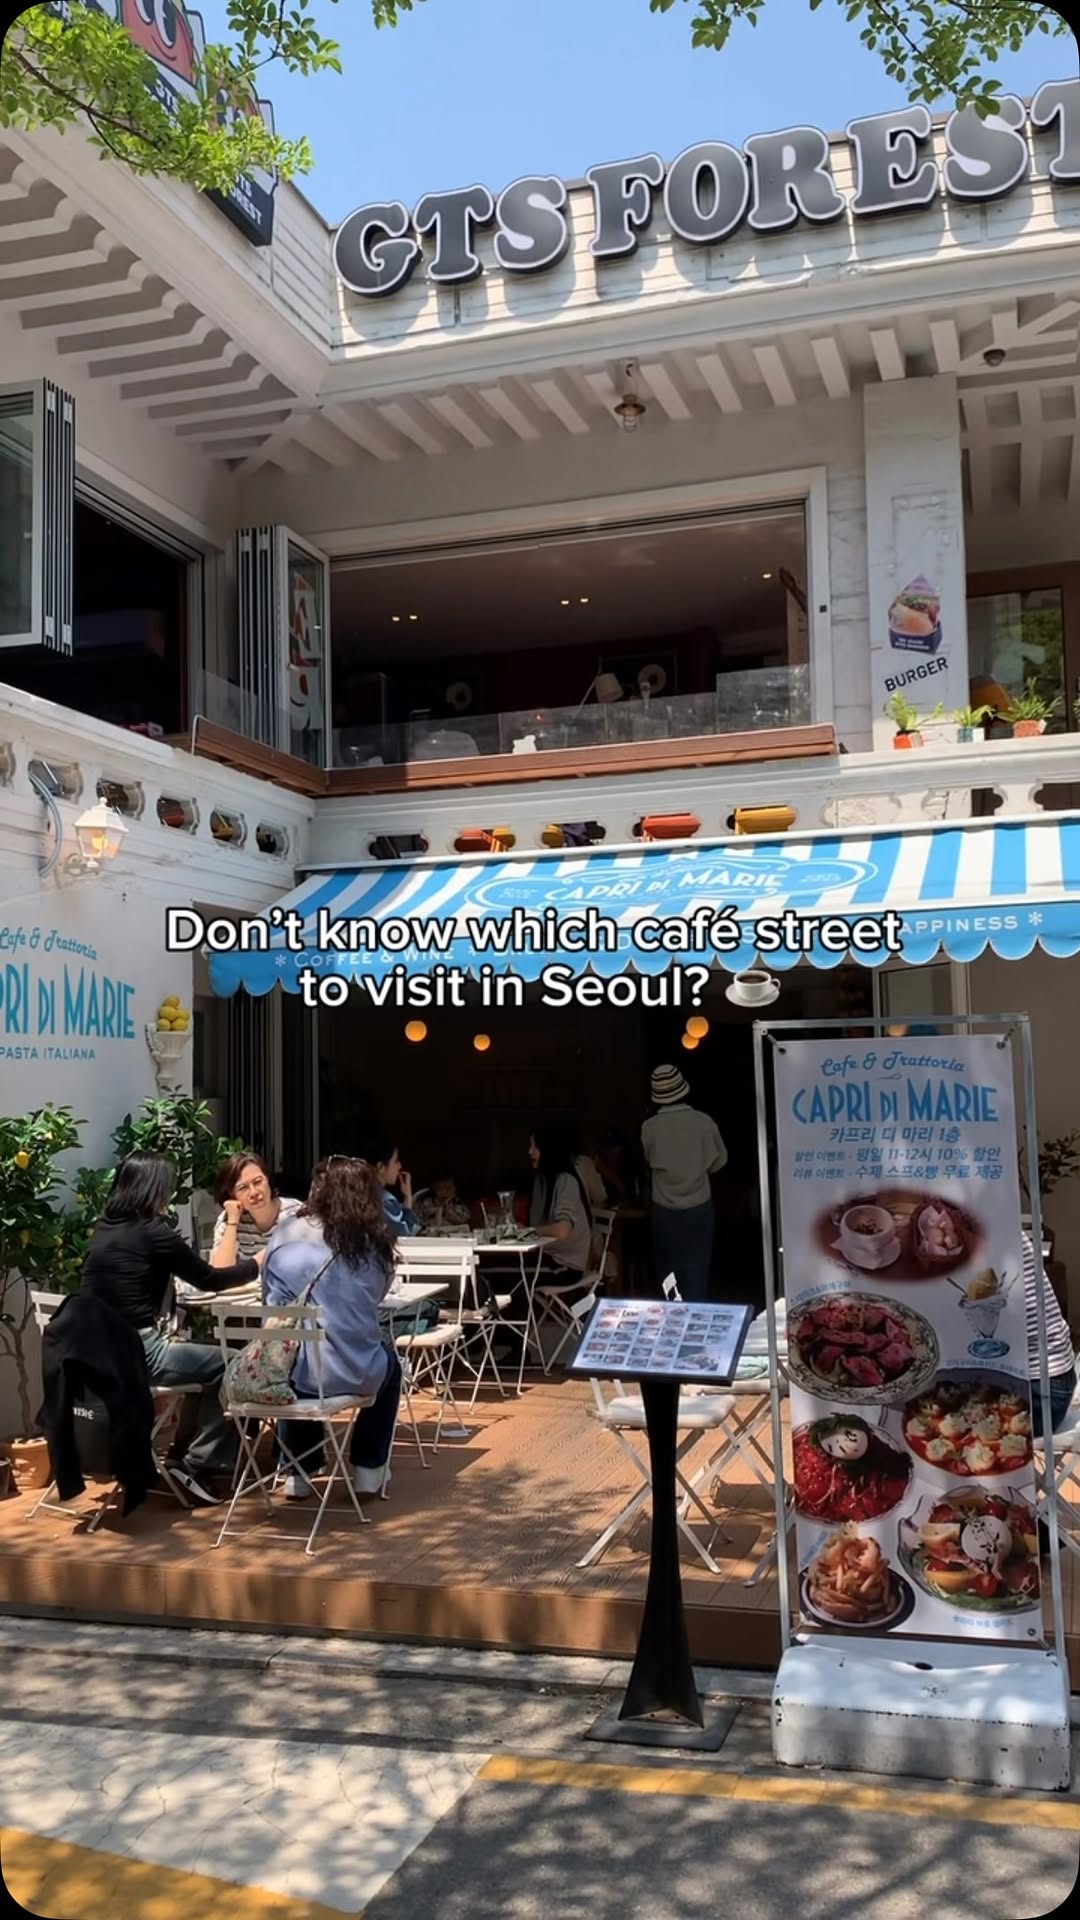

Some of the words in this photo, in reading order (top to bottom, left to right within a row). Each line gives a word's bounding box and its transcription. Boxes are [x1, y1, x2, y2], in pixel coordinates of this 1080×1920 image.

[333, 173, 568, 298] GTS
[586, 76, 1080, 260] FOREST
[884, 656, 949, 692] BURGER
[544, 880, 643, 900] CAPRI
[678, 868, 787, 887] MARIE
[899, 915, 1018, 935] APPINESS
[0, 926, 26, 954] Cafe
[44, 929, 97, 961] Trattoria
[0, 962, 29, 1035] RI
[38, 978, 55, 1036] DI
[64, 963, 135, 1039] MARIE
[43, 1047, 96, 1060] ITALIANA
[821, 1054, 857, 1078] Cafe
[863, 1052, 877, 1070] &
[882, 1051, 965, 1073] Trattoria
[792, 1080, 871, 1124] CAPRI
[879, 1091, 898, 1122] DI
[907, 1078, 999, 1123] MARIE
[829, 1126, 876, 1144] 카프리
[881, 1127, 897, 1143] 디
[902, 1126, 934, 1143] 마리
[937, 1148, 968, 1161] 10%
